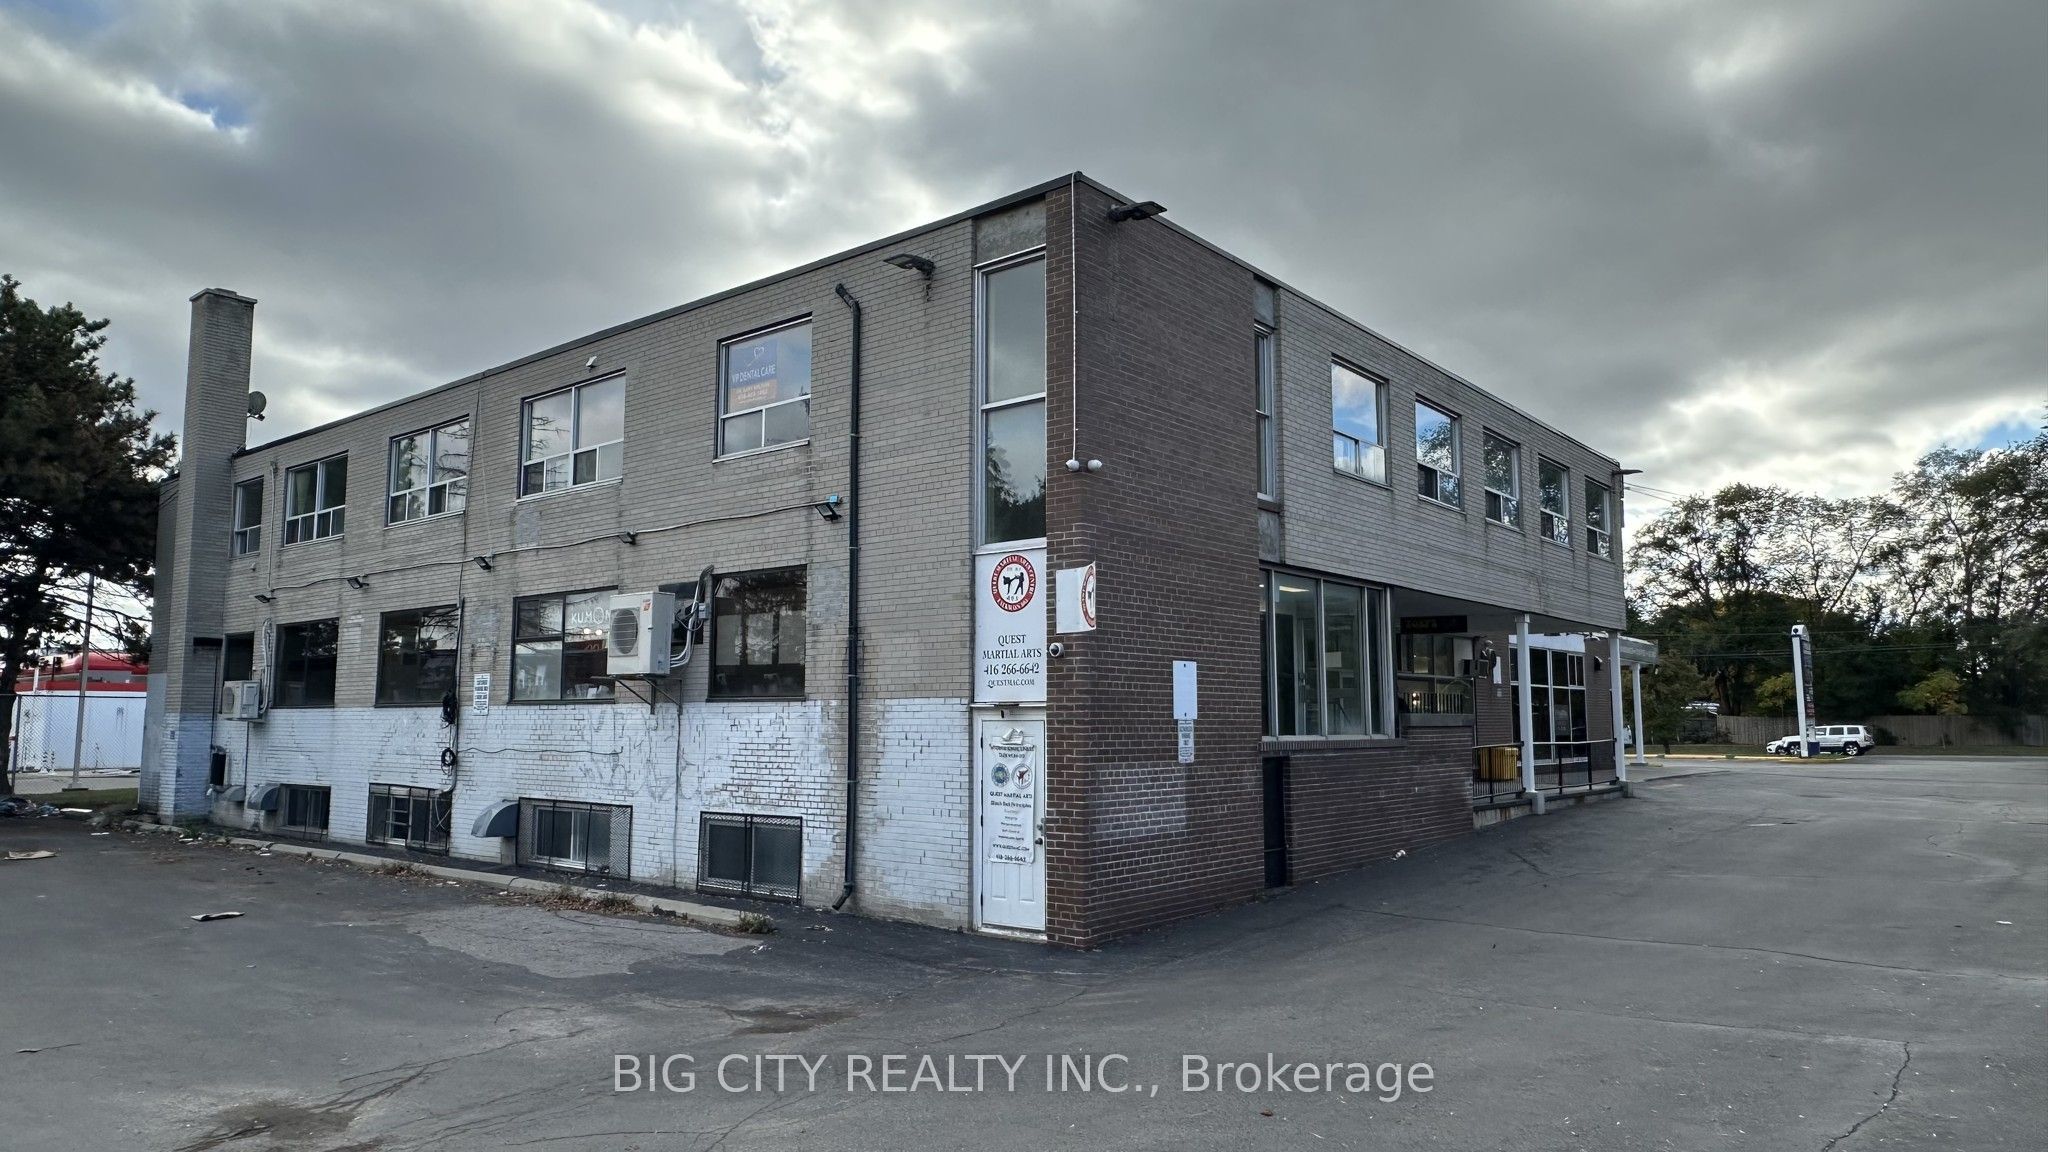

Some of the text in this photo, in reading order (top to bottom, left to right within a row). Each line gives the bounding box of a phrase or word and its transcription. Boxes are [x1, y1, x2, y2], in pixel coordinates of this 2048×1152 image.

[740, 368, 760, 382] DENTAL
[760, 364, 776, 377] CARE
[571, 607, 610, 624] KUMON
[997, 634, 1027, 647] QUEST
[982, 648, 1042, 660] MARTIAL ARTS
[984, 662, 1040, 675] 416 266-6642
[987, 679, 1035, 689] QUESTMAC.COM
